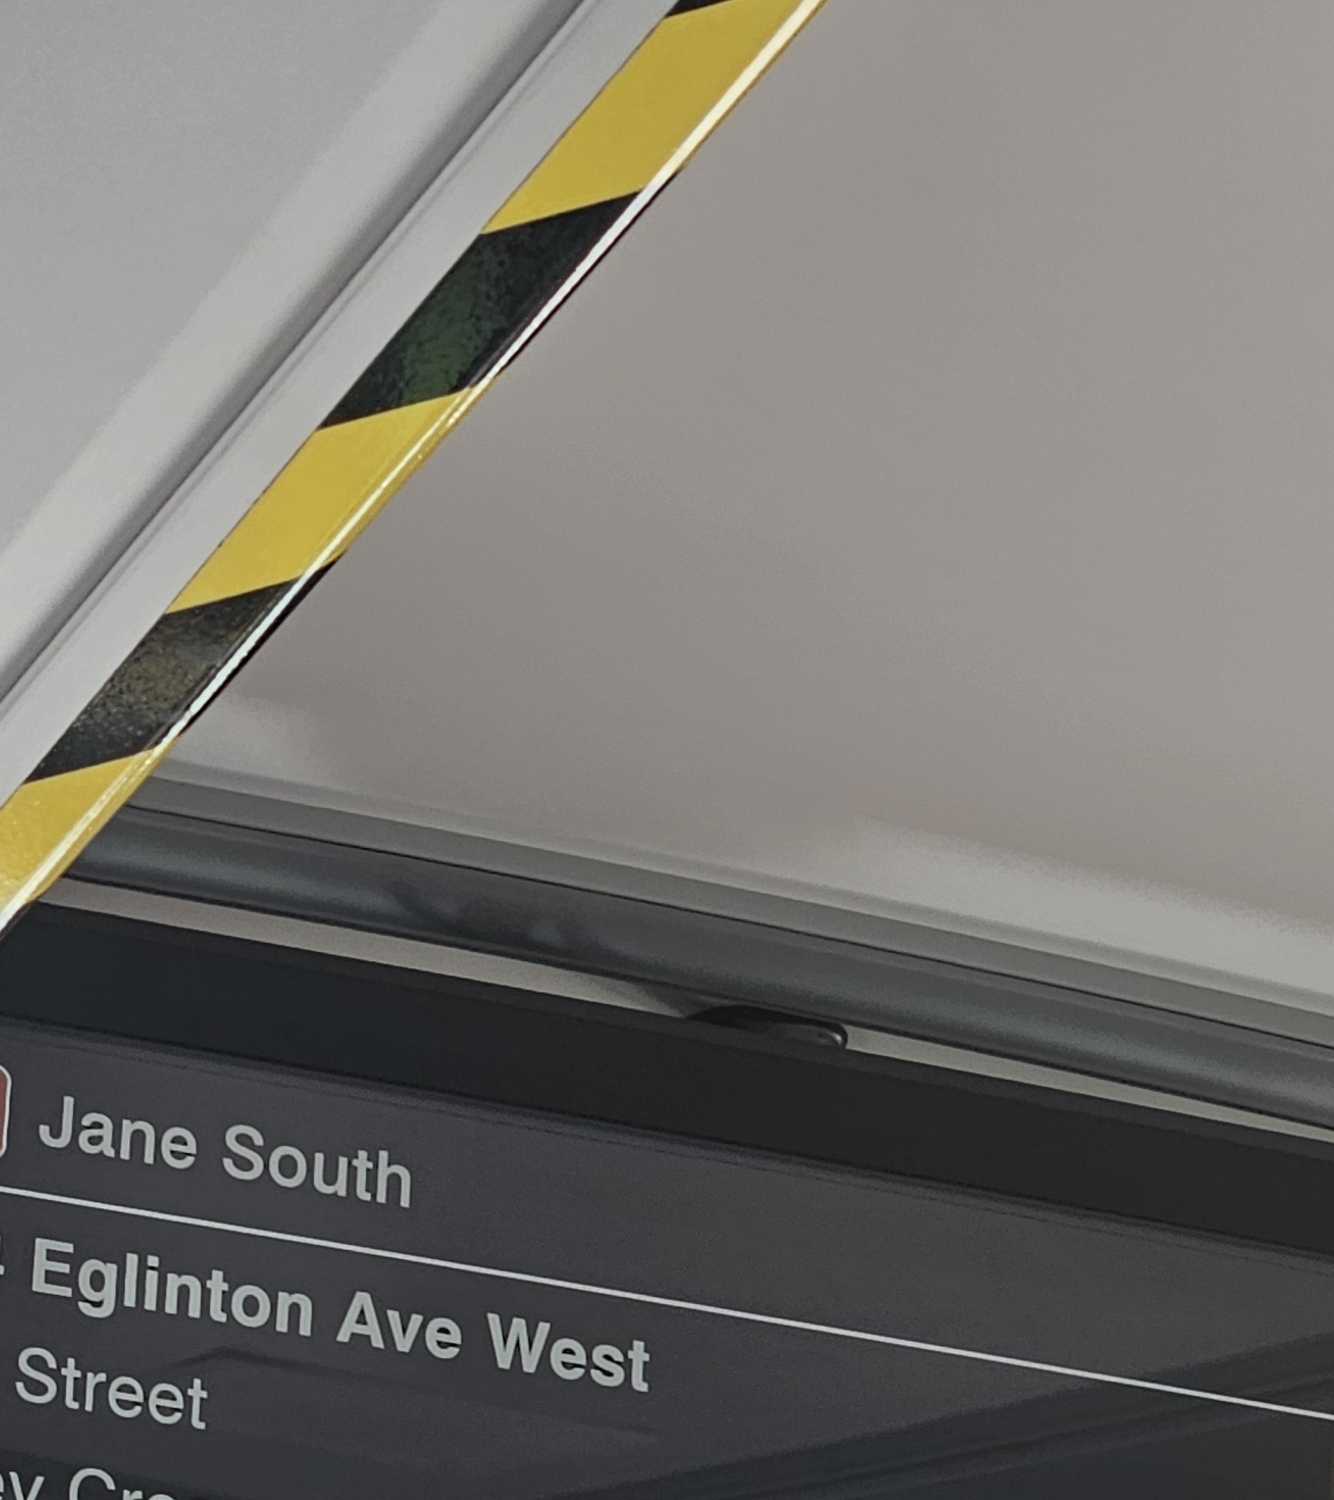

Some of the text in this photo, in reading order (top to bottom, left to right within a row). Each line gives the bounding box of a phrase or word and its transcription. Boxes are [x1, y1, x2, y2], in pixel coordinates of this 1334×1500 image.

[38, 1095, 411, 1208] Jane South
[31, 1237, 313, 1337] Eglinton
[336, 1291, 462, 1359] Ave
[486, 1312, 650, 1393] West
[15, 1347, 208, 1430] Street
